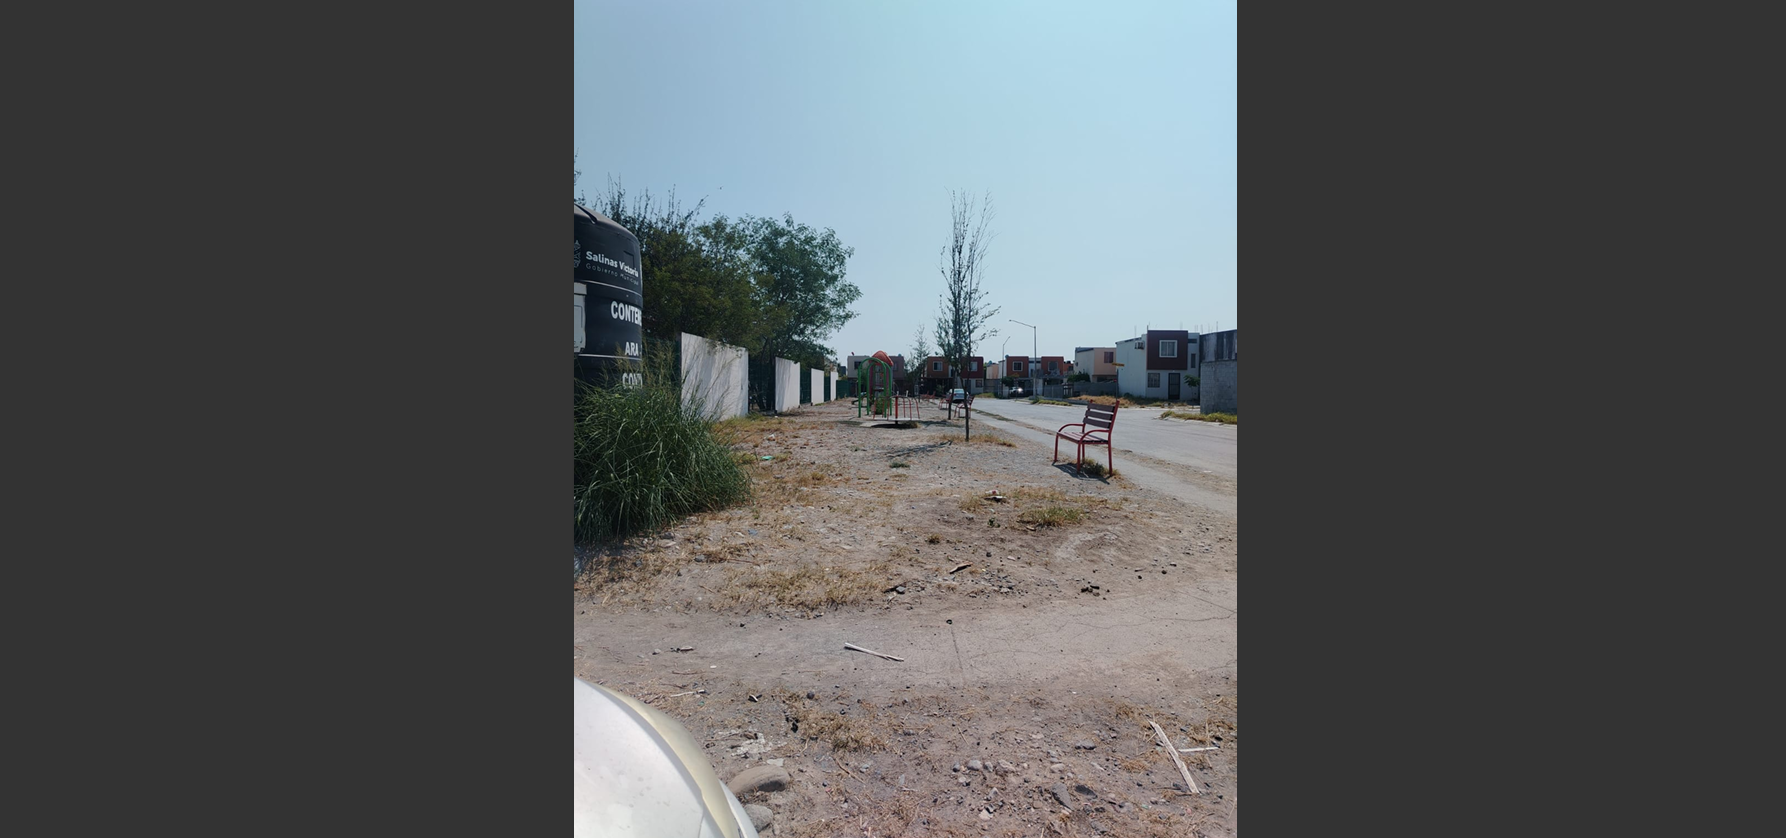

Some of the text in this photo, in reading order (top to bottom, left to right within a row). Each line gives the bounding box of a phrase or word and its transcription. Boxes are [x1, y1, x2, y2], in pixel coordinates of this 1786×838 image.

[586, 251, 639, 278] Salinas Victoria
[586, 263, 618, 277] Gobierno
[624, 341, 640, 356] ARA
